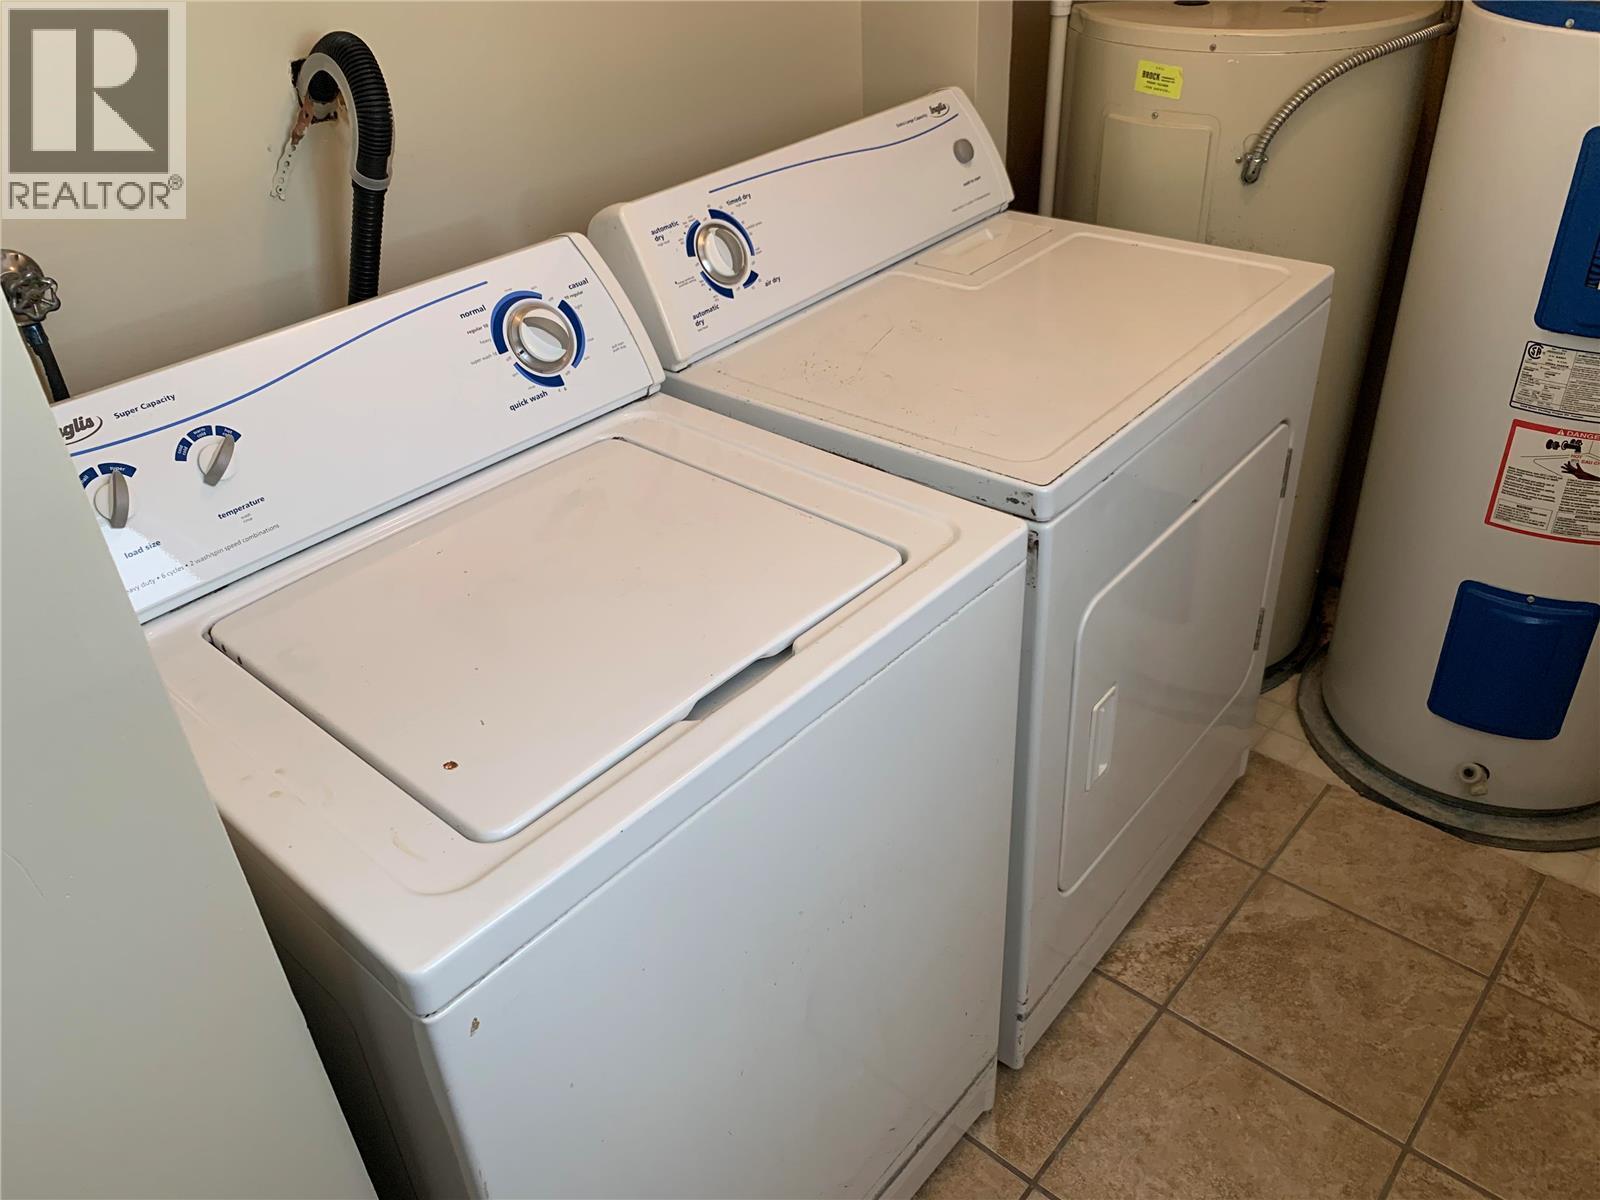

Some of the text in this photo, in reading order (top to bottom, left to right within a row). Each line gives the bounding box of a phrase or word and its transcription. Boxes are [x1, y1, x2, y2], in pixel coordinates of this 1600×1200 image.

[1142, 70, 1160, 81] BROCK
[726, 195, 742, 205] timed
[651, 221, 679, 235] automatic
[654, 234, 665, 242] dry
[568, 277, 589, 290] casual
[772, 276, 781, 284] dry
[459, 305, 487, 319] normal
[692, 304, 719, 320] automatic
[695, 319, 705, 327] dry
[113, 394, 176, 420] Super Capacity
[509, 390, 549, 412] quick wash
[217, 495, 266, 520] temperature
[124, 539, 161, 559] load size
[141, 578, 156, 588] duty
[167, 565, 185, 577] cycles
[224, 539, 242, 552] speed
[242, 523, 280, 543] combinations
